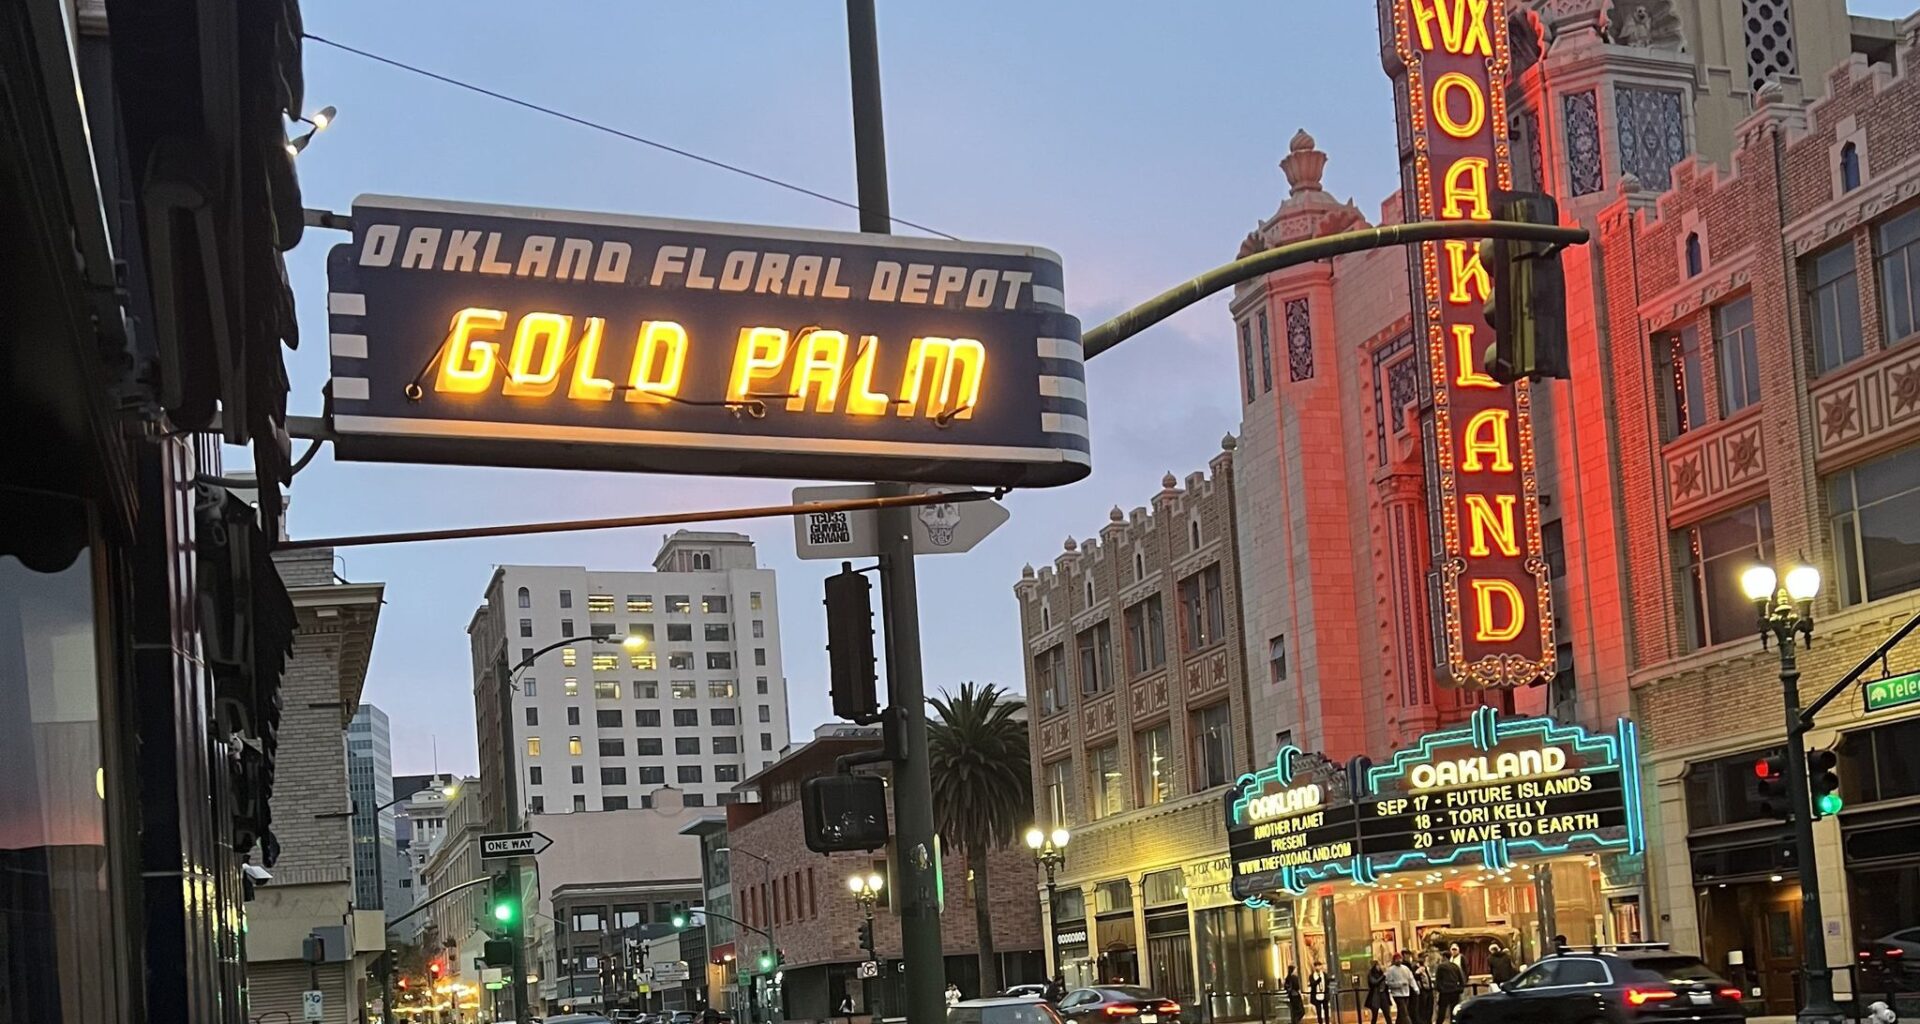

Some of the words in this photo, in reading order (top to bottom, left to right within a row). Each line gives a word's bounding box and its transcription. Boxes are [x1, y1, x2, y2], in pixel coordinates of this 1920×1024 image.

[1411, 0, 1494, 56] FOX
[359, 224, 632, 284] OAKLAND
[650, 245, 852, 299] FLORAL
[869, 262, 1033, 310] DEPOT
[435, 308, 689, 405] GOLD
[728, 325, 987, 420] PALM
[1432, 72, 1525, 642] OAKLAND
[810, 532, 850, 544] REMAND
[1888, 679, 1920, 699] Tele
[1411, 747, 1566, 788] OAKLAND
[1249, 784, 1320, 820] OAKLAND
[1376, 799, 1408, 816] SEP
[1413, 796, 1429, 812] 17
[1447, 785, 1513, 807] FUTURE
[1518, 775, 1592, 799] ISLANDS
[1254, 820, 1290, 840] ANOTHER
[1291, 812, 1324, 832] PLANET
[1413, 832, 1432, 849] 20
[1451, 823, 1502, 844] WAVE
[1507, 821, 1532, 838] TO
[1538, 813, 1599, 834] EARTH
[1414, 815, 1431, 830] 18
[1449, 807, 1489, 826] TORI
[1494, 800, 1547, 820] KELLY
[488, 841, 508, 850] ONE
[512, 839, 531, 848] WAY
[1239, 842, 1351, 875] WWW.THEFOXOAKLAND.COM
[1271, 833, 1307, 852] PRESENT
